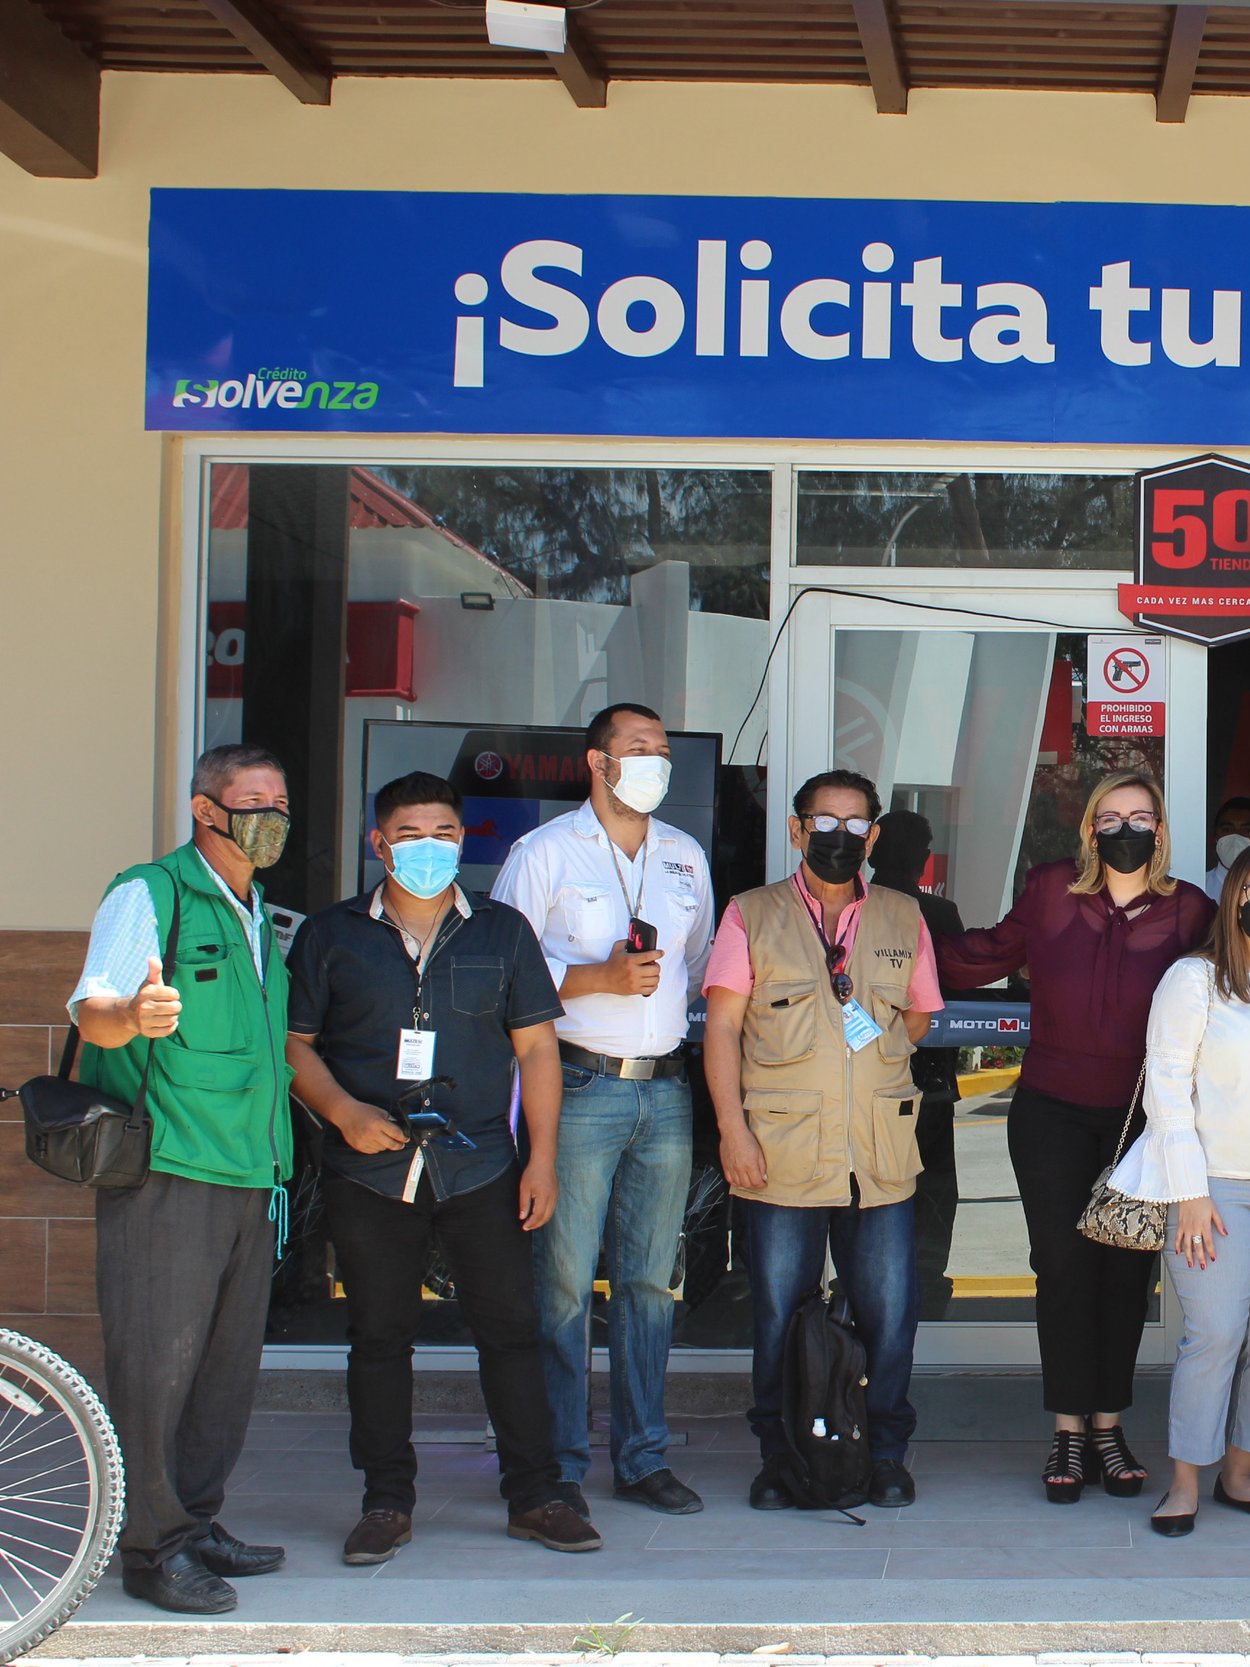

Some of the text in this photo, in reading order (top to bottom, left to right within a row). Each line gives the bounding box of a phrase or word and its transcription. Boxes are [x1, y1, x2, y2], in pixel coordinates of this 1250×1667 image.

[453, 239, 1056, 388] ¡Solicita
[1089, 260, 1242, 368] tu
[257, 367, 307, 381] Crédito
[172, 373, 380, 410] Solvenza
[1136, 596, 1164, 605] CADA
[1168, 597, 1188, 605] VEZ
[1192, 597, 1215, 606] MAS
[1100, 704, 1152, 713] PROHIBIDO
[1100, 714, 1153, 723] EL INGRESO
[1099, 725, 1154, 733] CON ARMAS
[507, 753, 592, 783] YAMAH
[874, 948, 913, 960] VILLAMIX
[890, 958, 903, 969] TV
[949, 1017, 1031, 1032] MOTOMU
